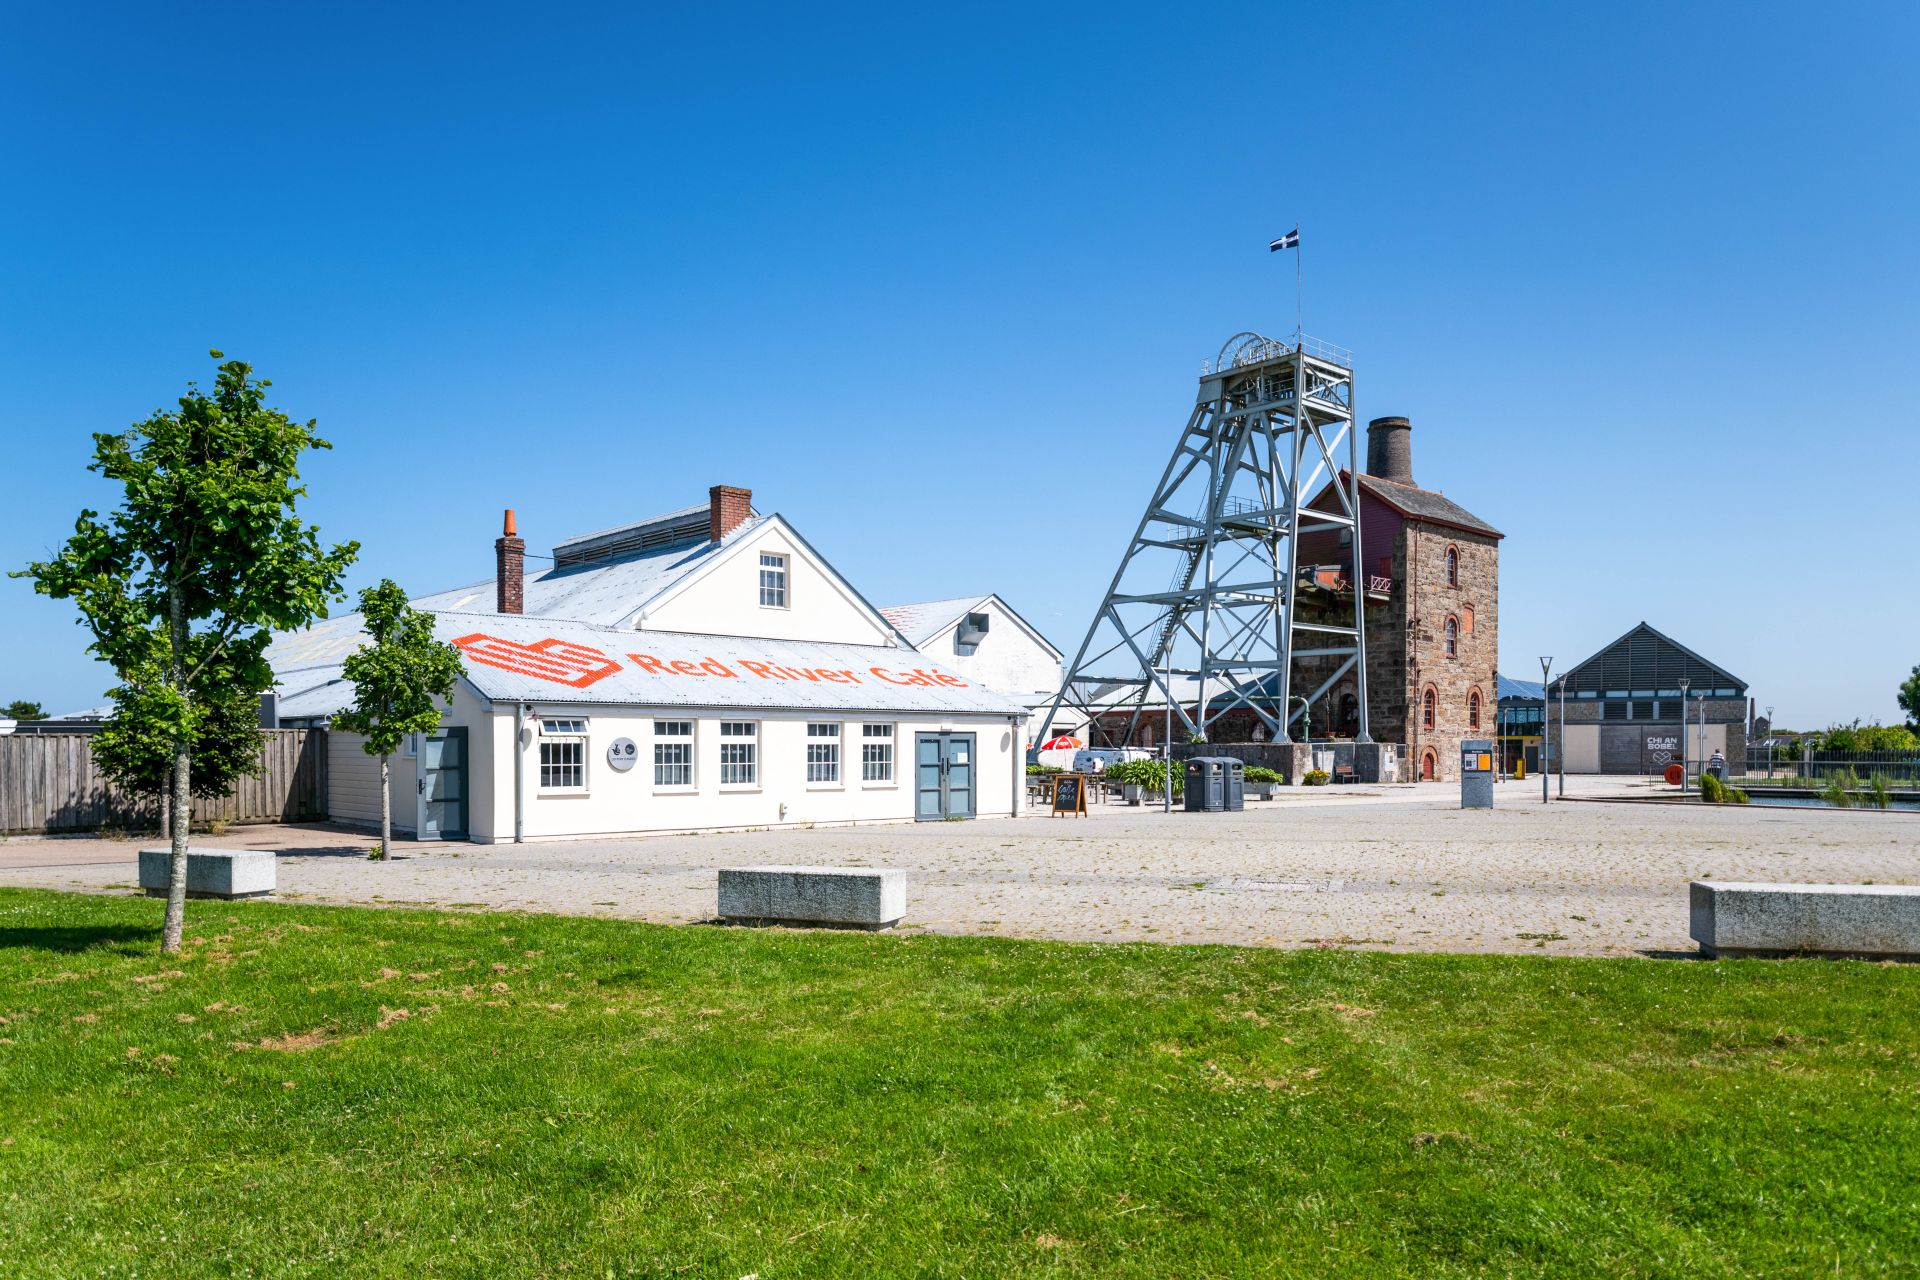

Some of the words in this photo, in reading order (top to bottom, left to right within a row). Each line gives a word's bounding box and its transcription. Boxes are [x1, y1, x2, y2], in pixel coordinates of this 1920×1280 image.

[625, 653, 739, 678] Red
[736, 659, 863, 684] River
[869, 667, 969, 688] Café
